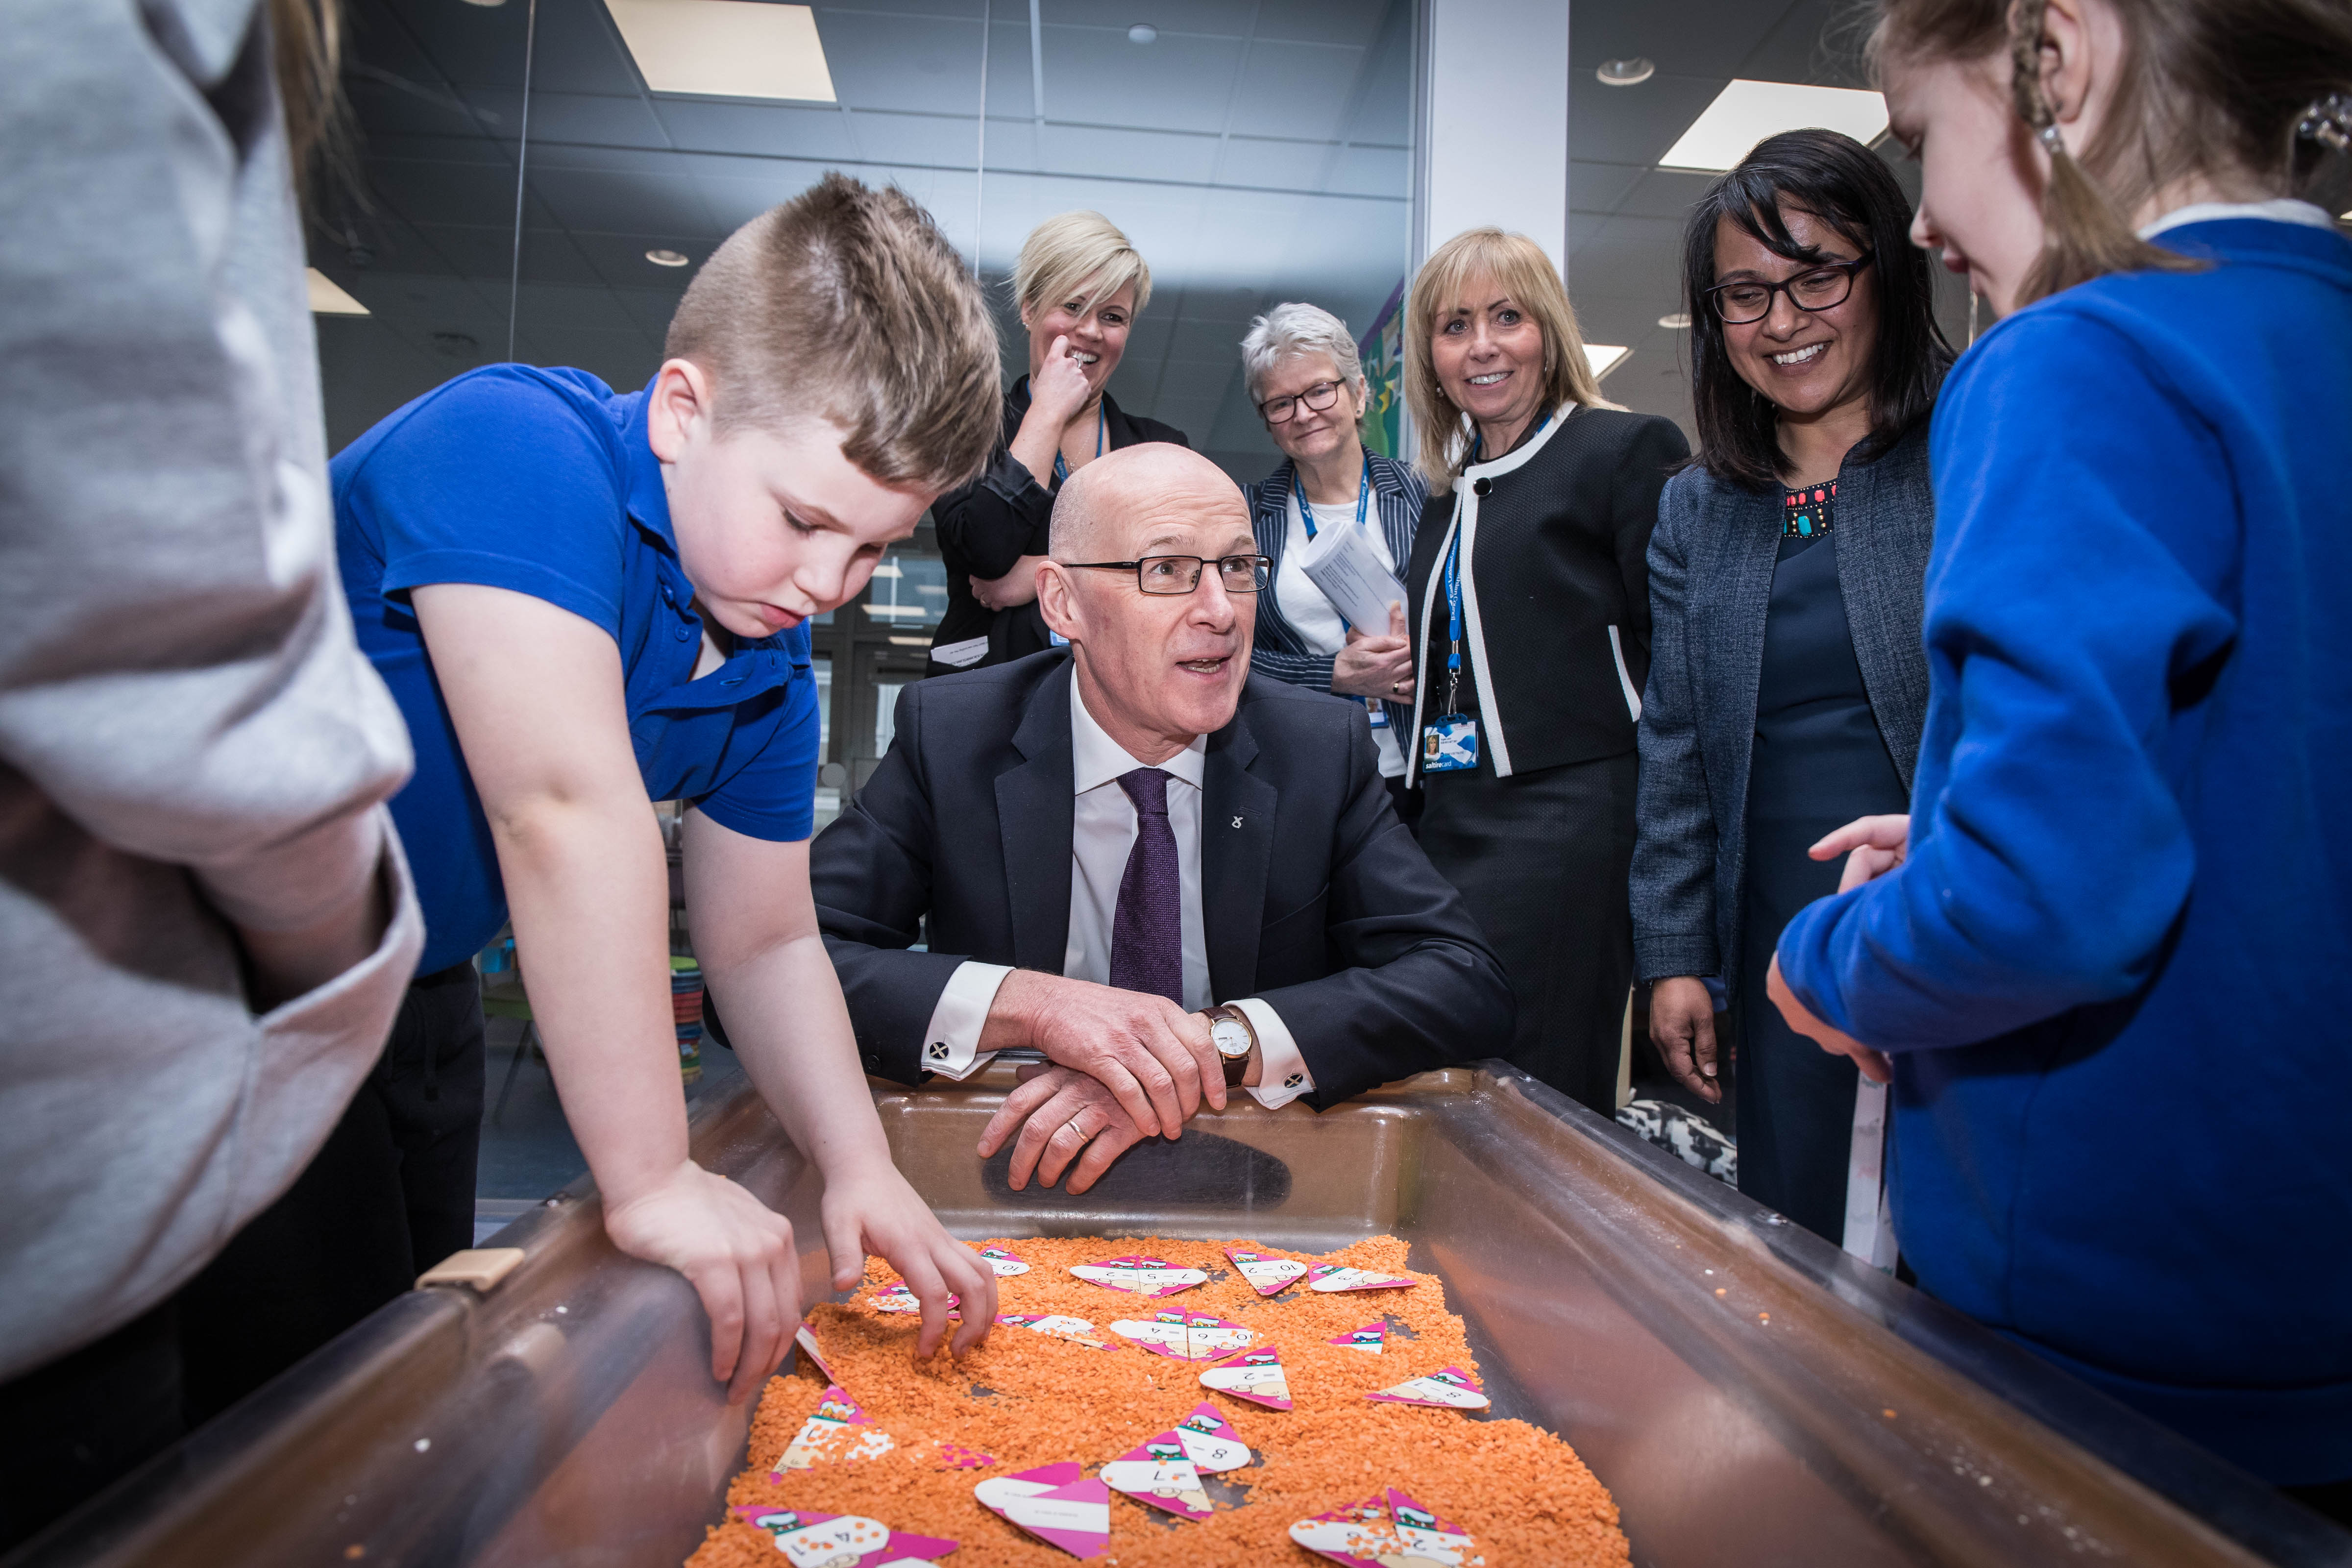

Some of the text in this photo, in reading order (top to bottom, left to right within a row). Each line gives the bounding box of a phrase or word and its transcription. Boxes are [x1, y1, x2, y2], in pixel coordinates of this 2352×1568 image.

[1425, 760, 1451, 769] saltirecard
[1212, 1448, 1227, 1459] 8
[1154, 1470, 1165, 1481] 7
[834, 1531, 850, 1543] 4
